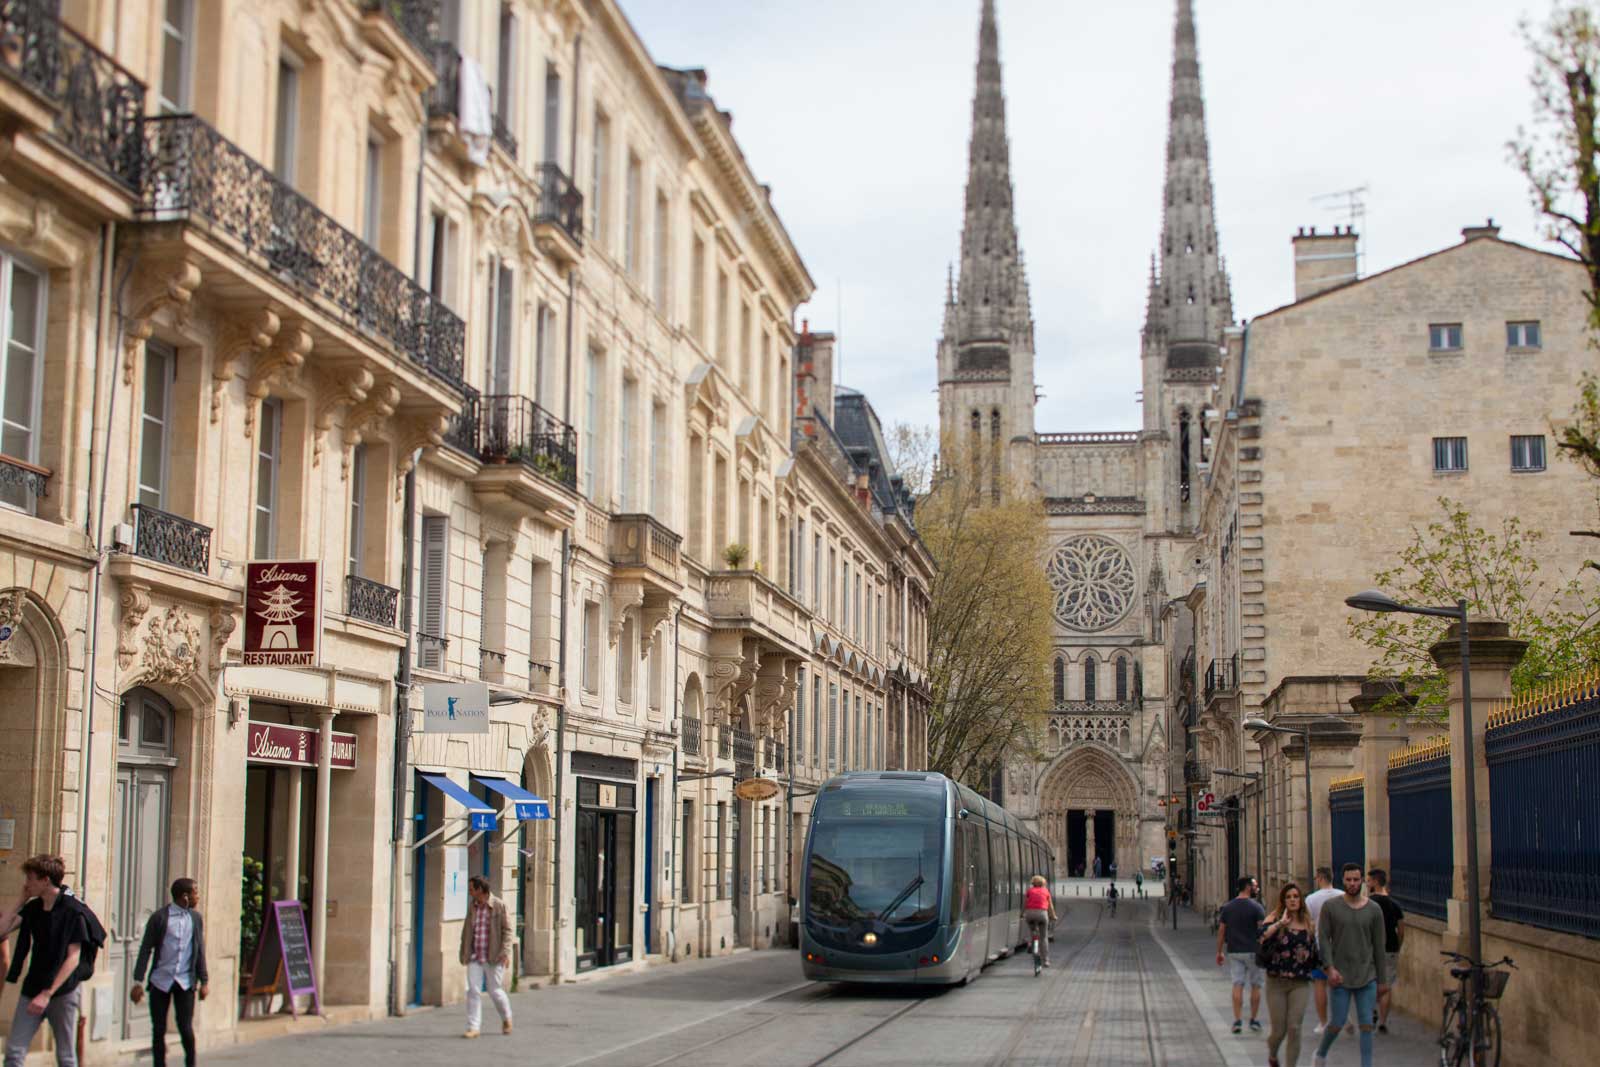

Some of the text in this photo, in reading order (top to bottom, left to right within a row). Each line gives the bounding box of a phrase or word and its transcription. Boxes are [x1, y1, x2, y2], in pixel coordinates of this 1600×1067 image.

[256, 564, 308, 584] Asiana
[243, 653, 314, 665] RESTAURANT
[427, 708, 486, 718] POLO NATION
[251, 726, 356, 761] Asiana TAURANT
